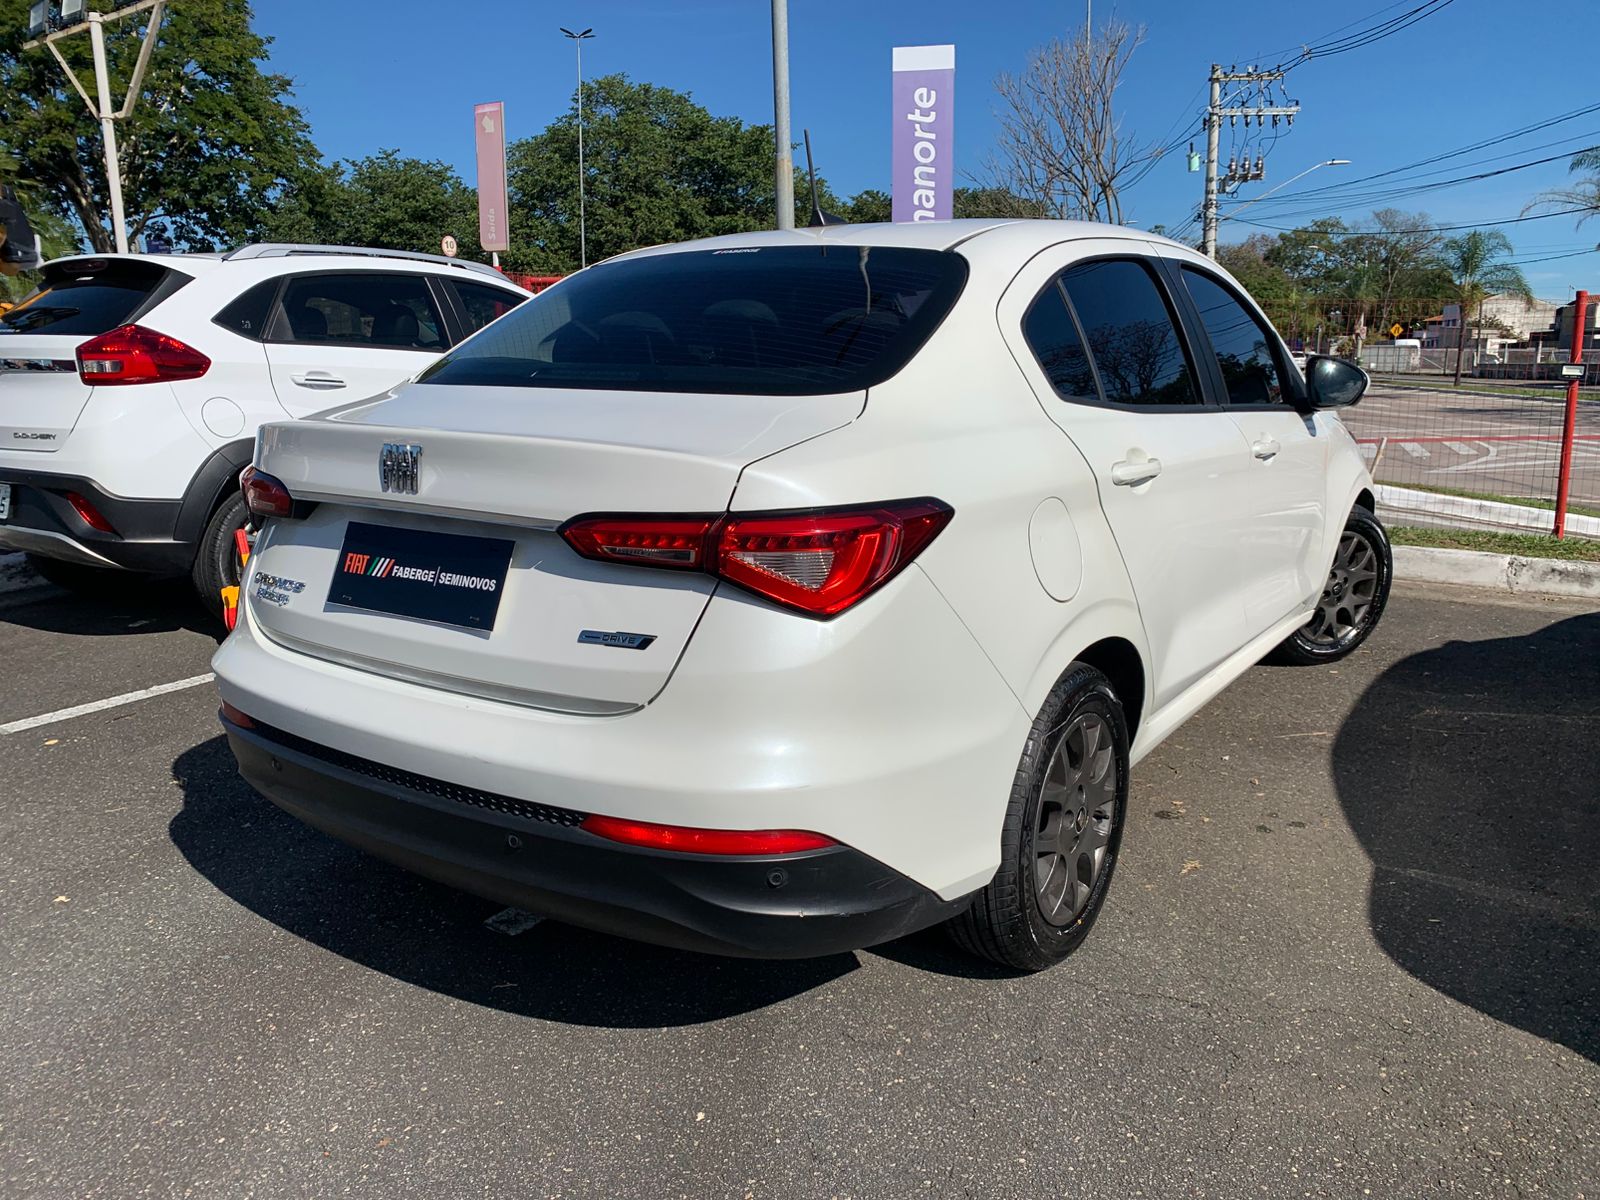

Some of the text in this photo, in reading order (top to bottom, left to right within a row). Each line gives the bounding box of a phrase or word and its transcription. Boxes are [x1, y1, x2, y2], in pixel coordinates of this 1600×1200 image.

[488, 208, 496, 240] Saída
[445, 240, 455, 249] 10
[344, 552, 497, 592] FIAT FABERGE SEMINOVOS
[602, 634, 637, 644] DRIVE
